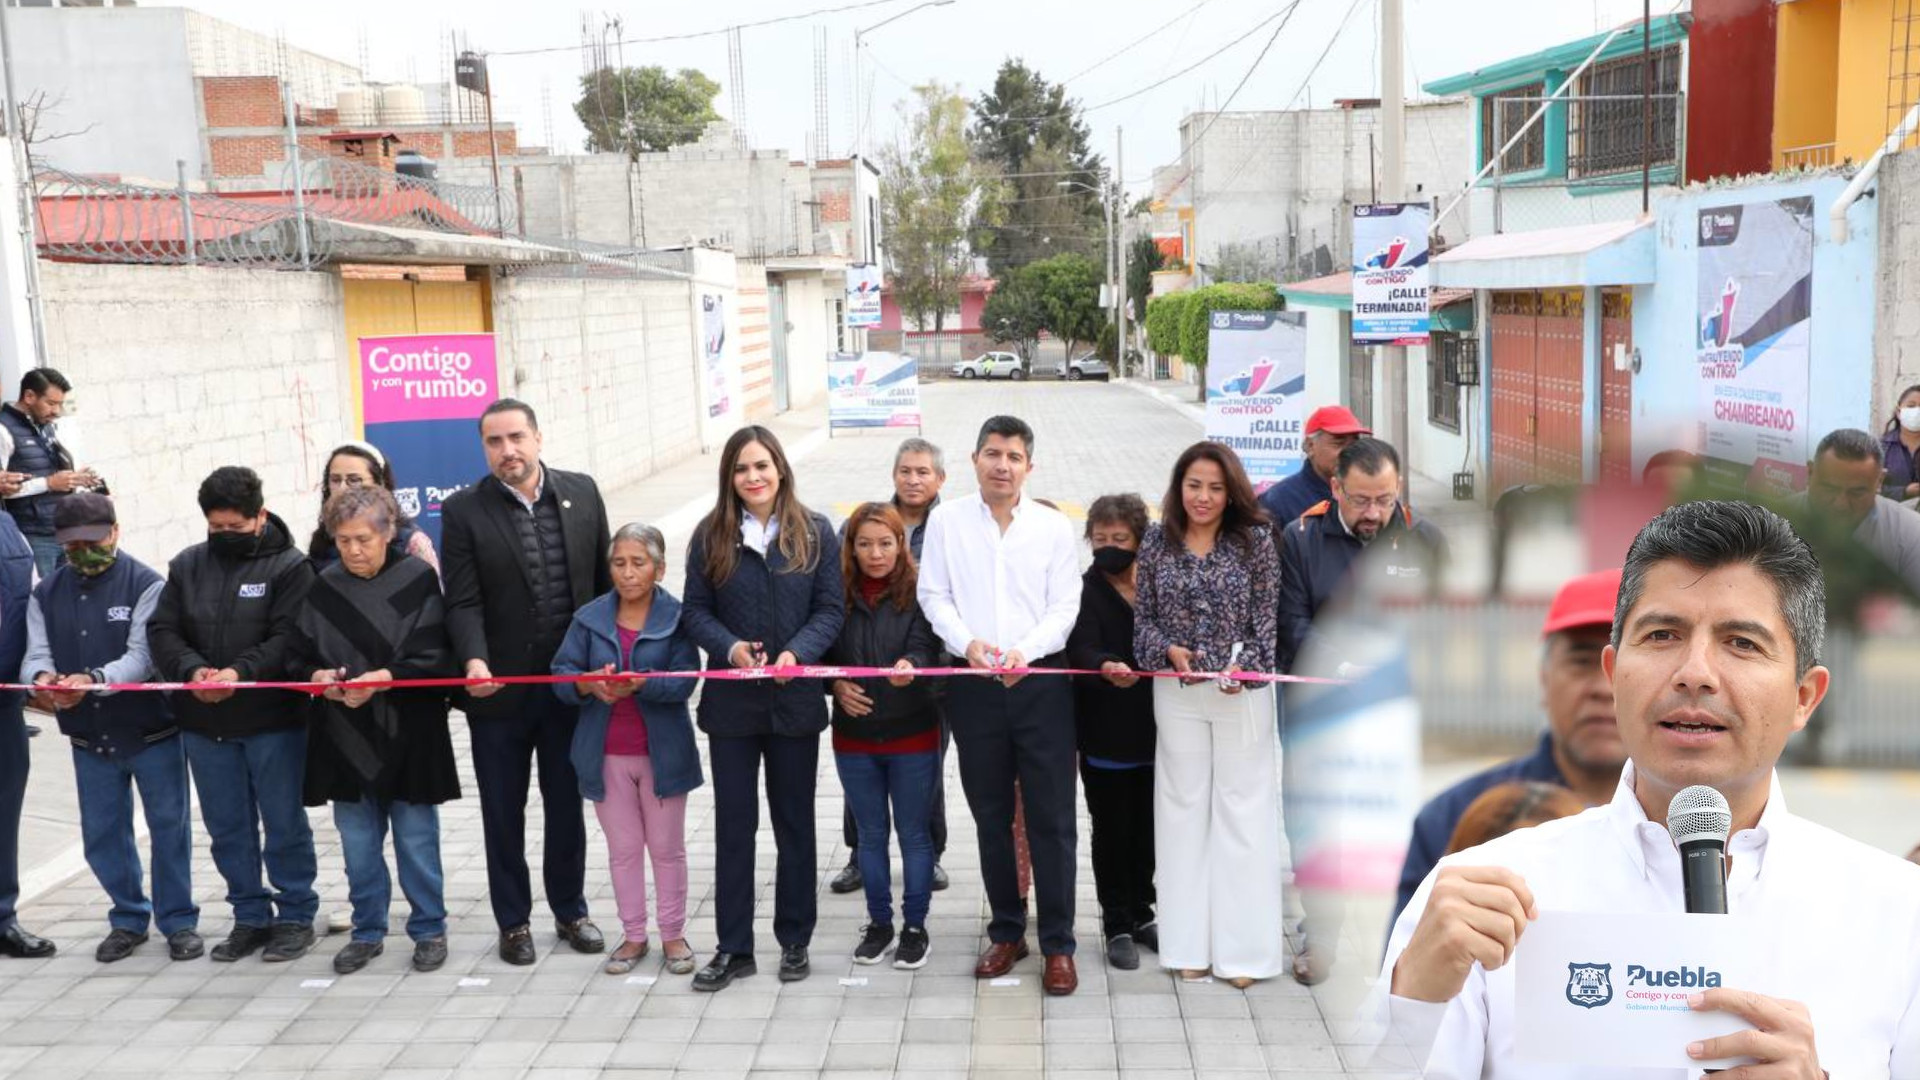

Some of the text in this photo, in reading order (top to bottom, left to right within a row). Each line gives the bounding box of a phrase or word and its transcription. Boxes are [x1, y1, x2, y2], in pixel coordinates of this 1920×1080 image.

[1389, 288, 1428, 301] ¡CALLE
[1356, 302, 1427, 314] TERMINADA!
[369, 345, 472, 379] Contigo
[1702, 363, 1737, 379] CONTIGO
[372, 371, 488, 399] y con rumbo
[1221, 405, 1273, 415] CONTIGO
[1714, 399, 1795, 431] CHAMBEANDO
[1250, 419, 1301, 435] ¡CALLE
[1627, 964, 1722, 988] Puebla
[1626, 989, 1661, 1001] Contigo
[1663, 993, 1670, 1001] y
[1626, 1003, 1692, 1013] Gobierno Municipa
